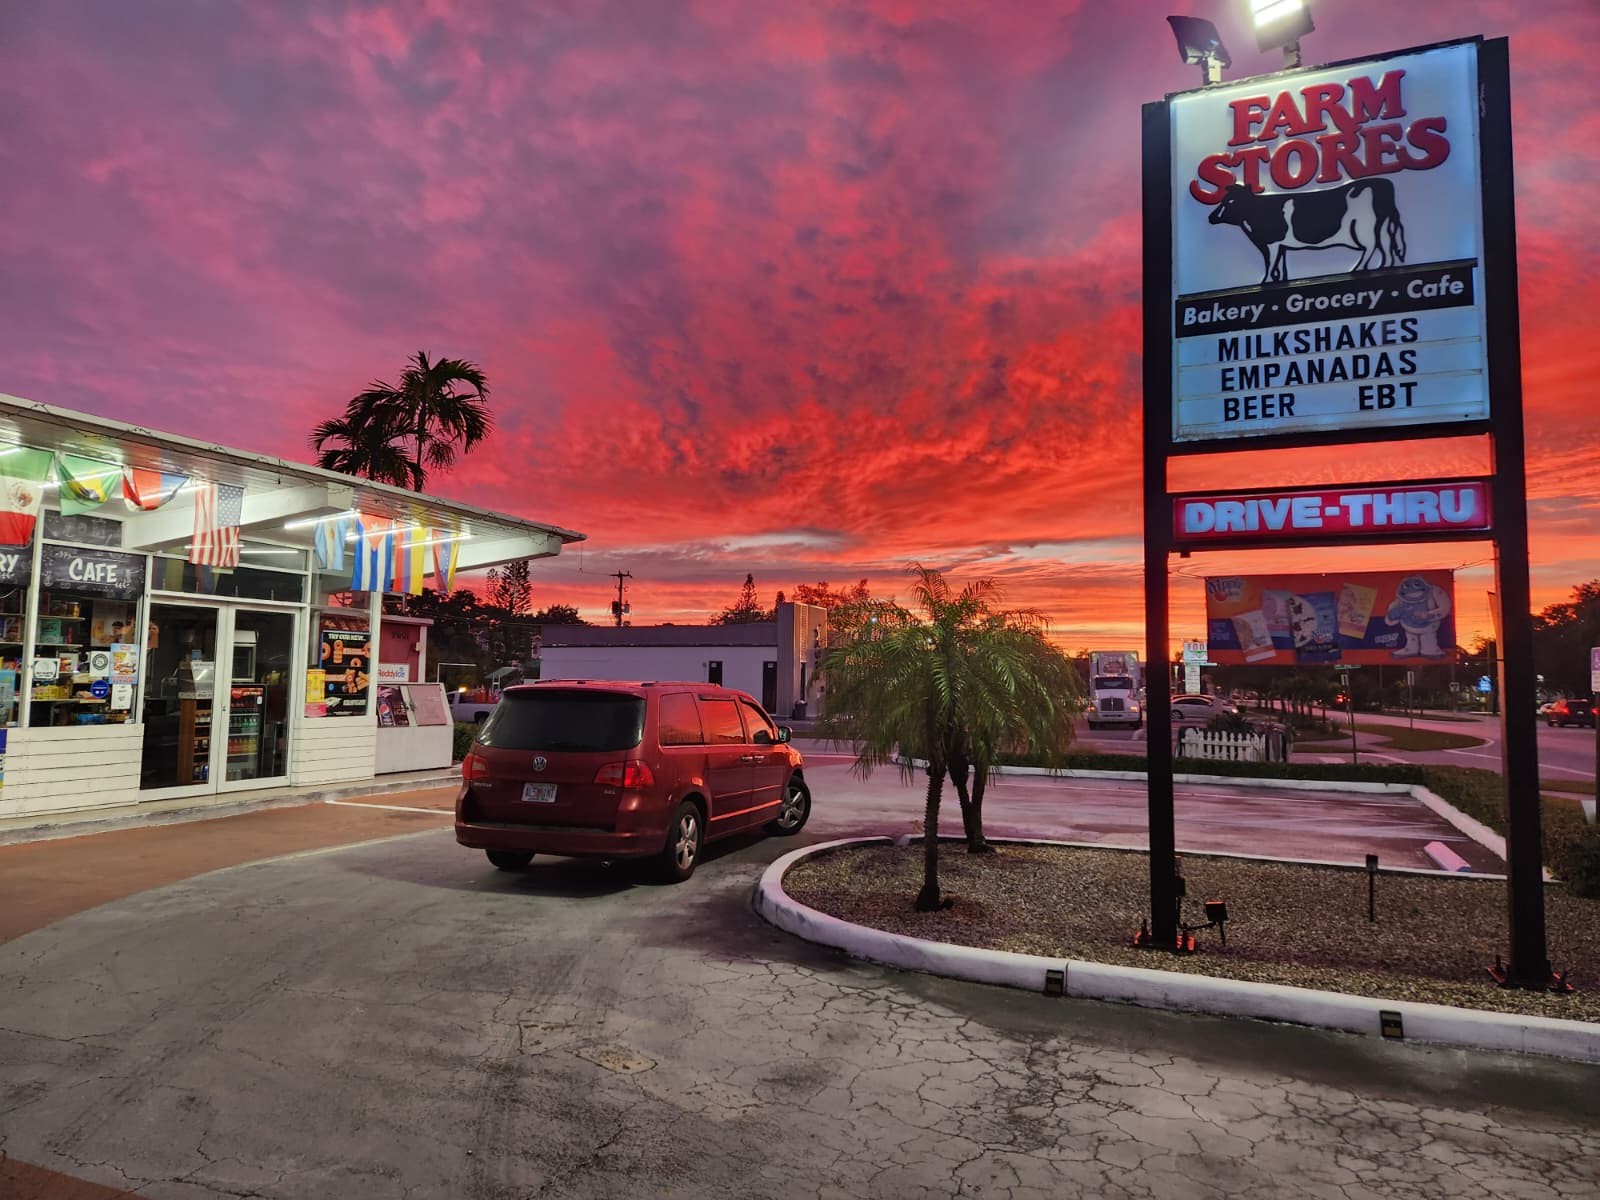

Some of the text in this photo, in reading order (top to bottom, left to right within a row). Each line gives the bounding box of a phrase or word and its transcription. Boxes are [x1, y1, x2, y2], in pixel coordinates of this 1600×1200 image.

[1228, 70, 1406, 147] FARM
[1189, 117, 1451, 205] STORES
[1183, 275, 1465, 326] Bakery Grocery Cafe
[1217, 318, 1419, 362] MILKSHAKES
[1221, 350, 1418, 392] EMPANADAS
[1224, 382, 1418, 422] BEER EBT
[1184, 488, 1477, 534] DRIVE-THRU
[68, 557, 119, 583] CAFE
